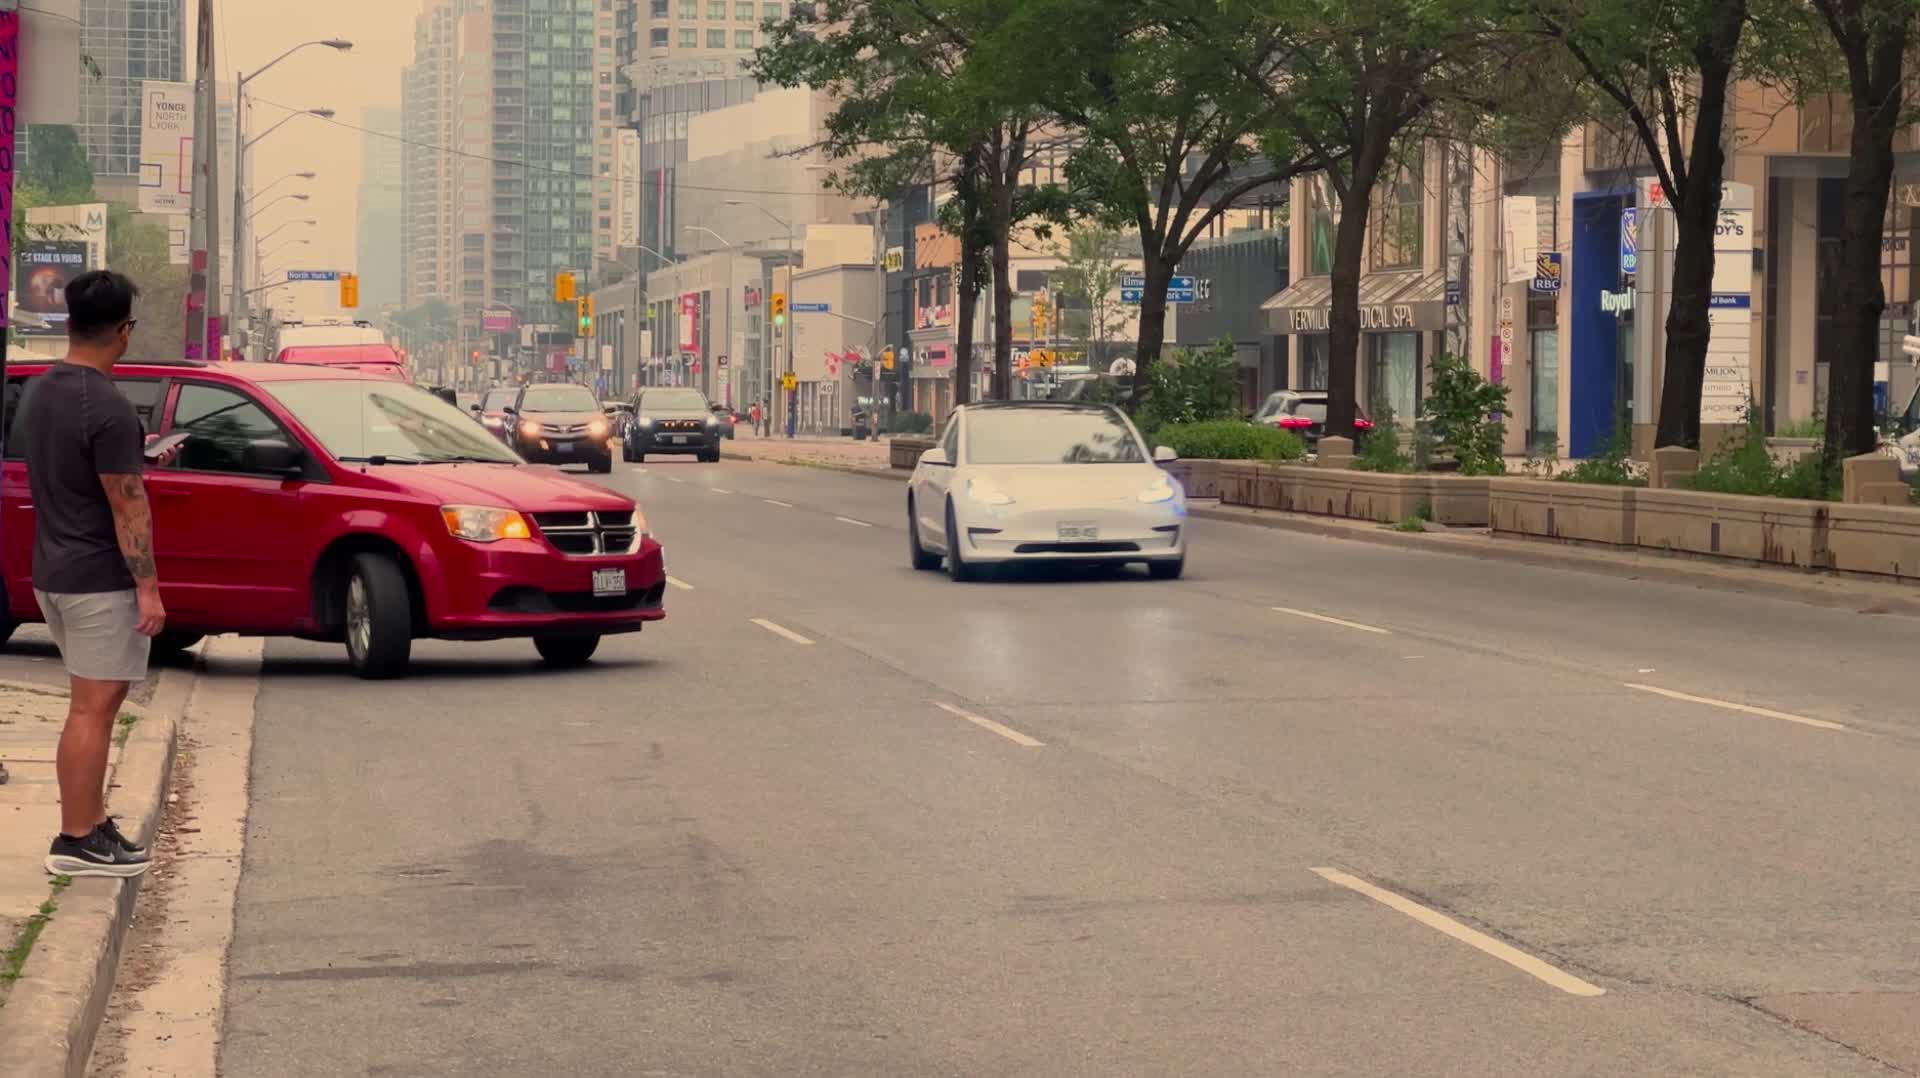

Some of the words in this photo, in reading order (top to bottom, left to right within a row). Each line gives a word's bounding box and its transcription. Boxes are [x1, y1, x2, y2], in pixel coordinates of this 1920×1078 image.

[156, 102, 187, 112] YONGE
[155, 112, 187, 121] NORTH
[155, 121, 180, 130] YORK
[1715, 225, 1744, 236] DY'S
[33, 253, 52, 263] STAGE
[53, 253, 60, 263] IS
[61, 254, 82, 263] YOURS
[288, 272, 307, 280] North
[1536, 280, 1559, 289] RBC
[1601, 287, 1631, 317] Royal
[1360, 306, 1390, 329] DICAL
[1393, 304, 1414, 327] SPA
[821, 385, 832, 393] 40
